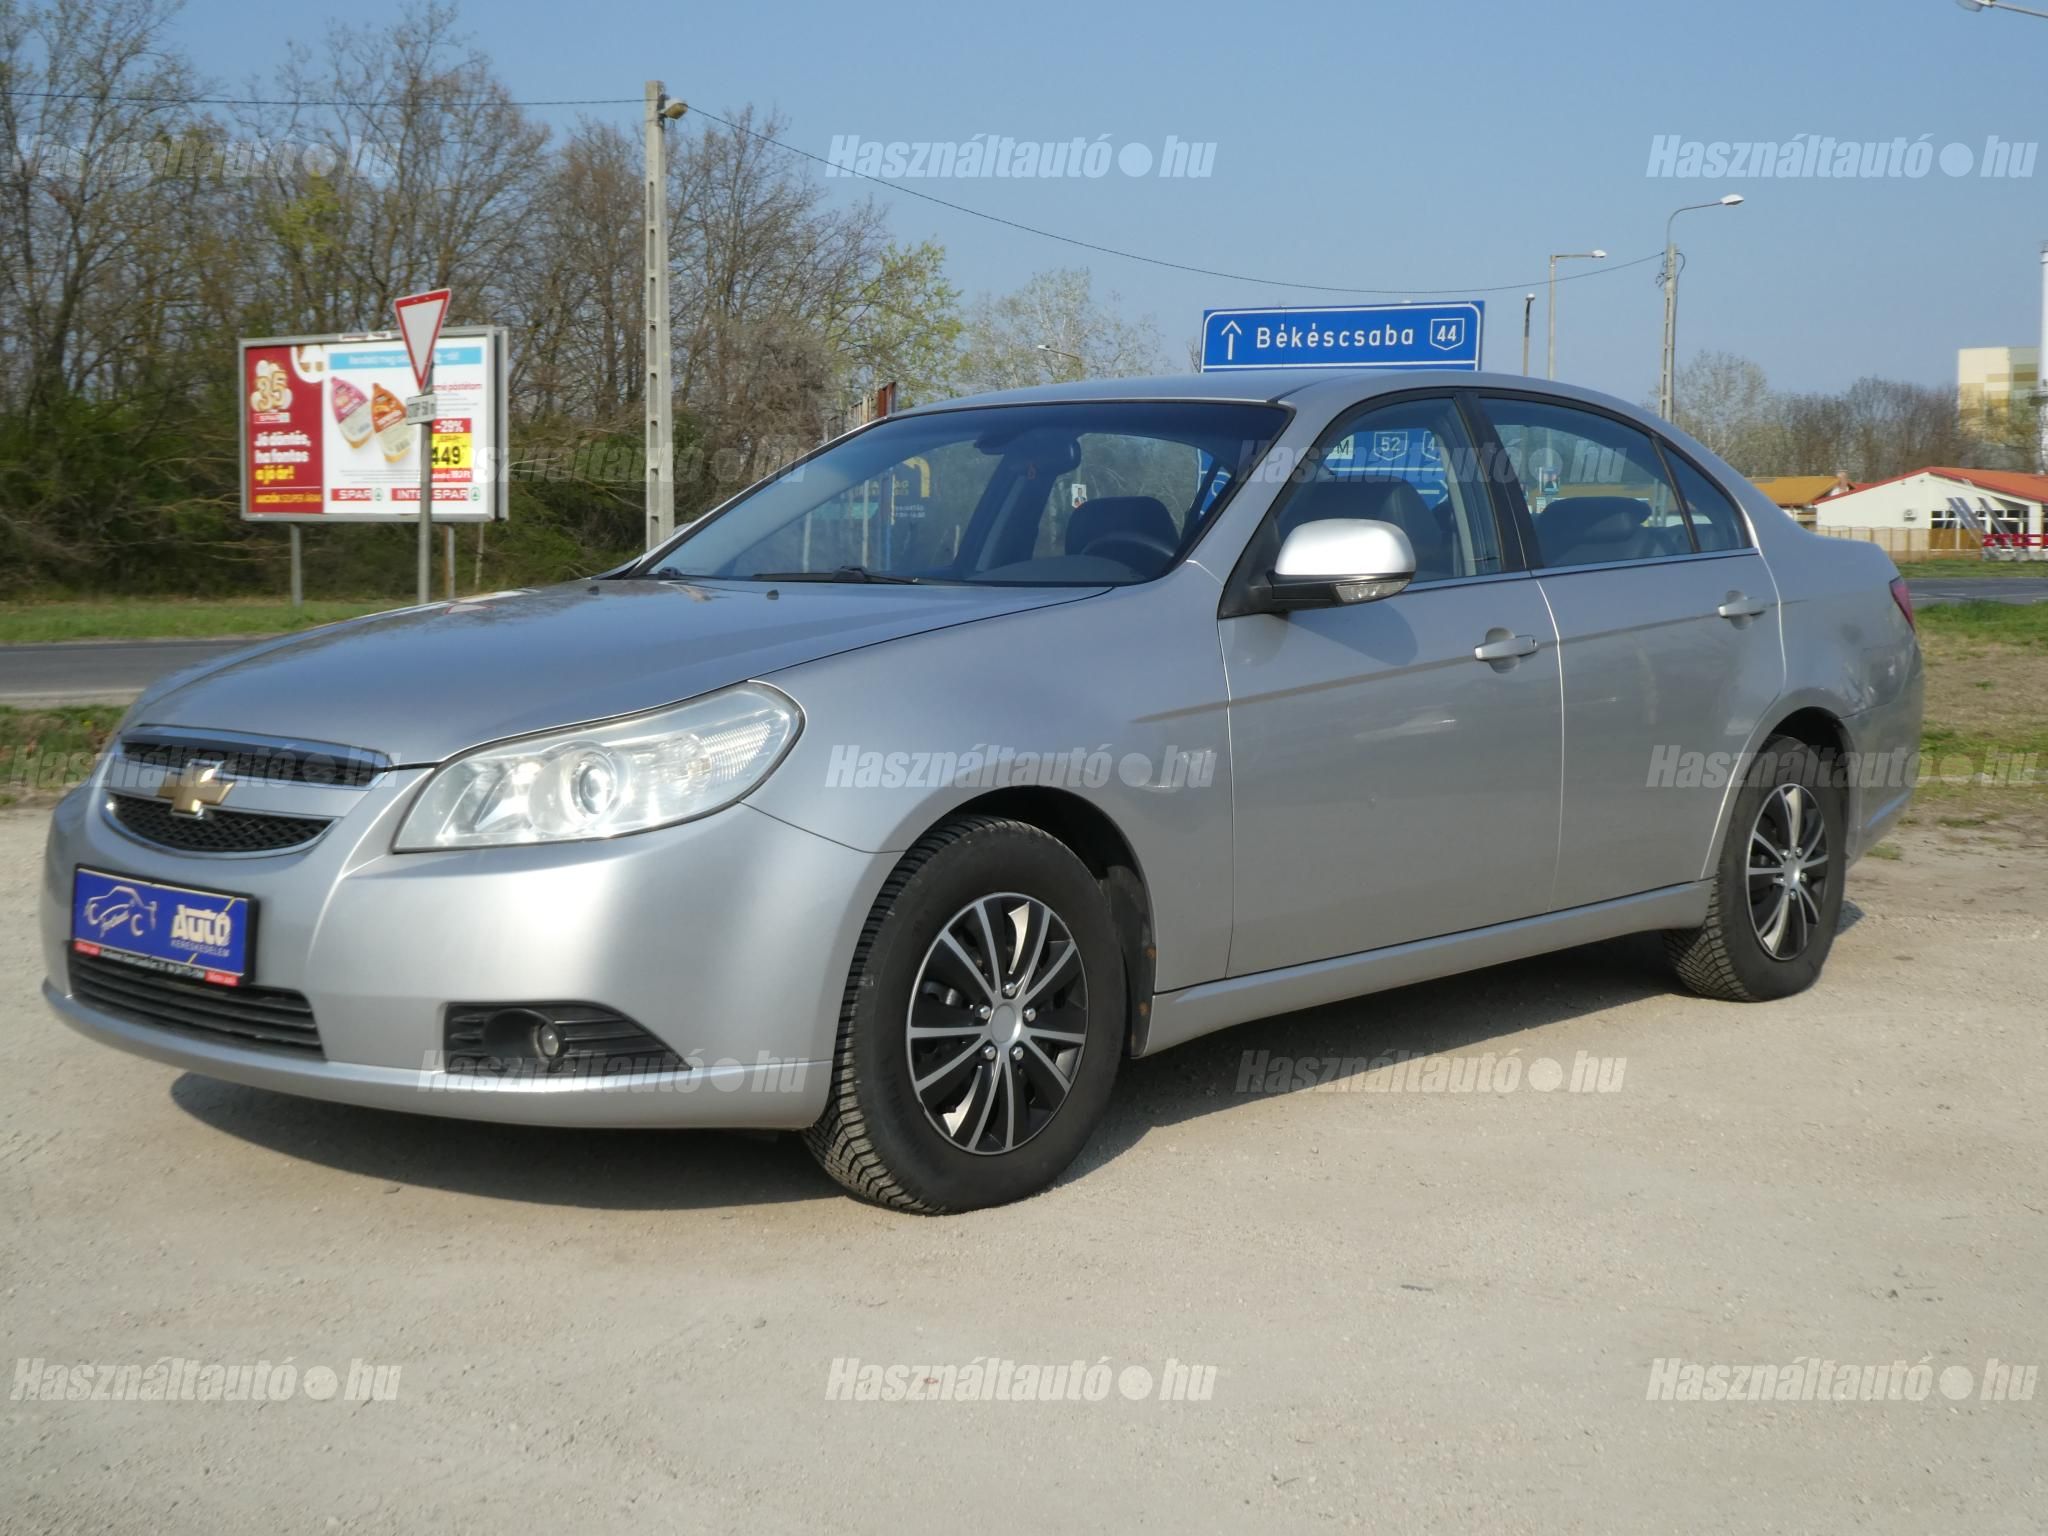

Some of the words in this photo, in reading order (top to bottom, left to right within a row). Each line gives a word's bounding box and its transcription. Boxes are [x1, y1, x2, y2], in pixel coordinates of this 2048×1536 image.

[1257, 322, 1414, 348] Békéscsaba
[1437, 325, 1457, 342] 44
[1381, 436, 1401, 452] 52
[431, 446, 461, 465] 449
[338, 489, 372, 500] SPAR
